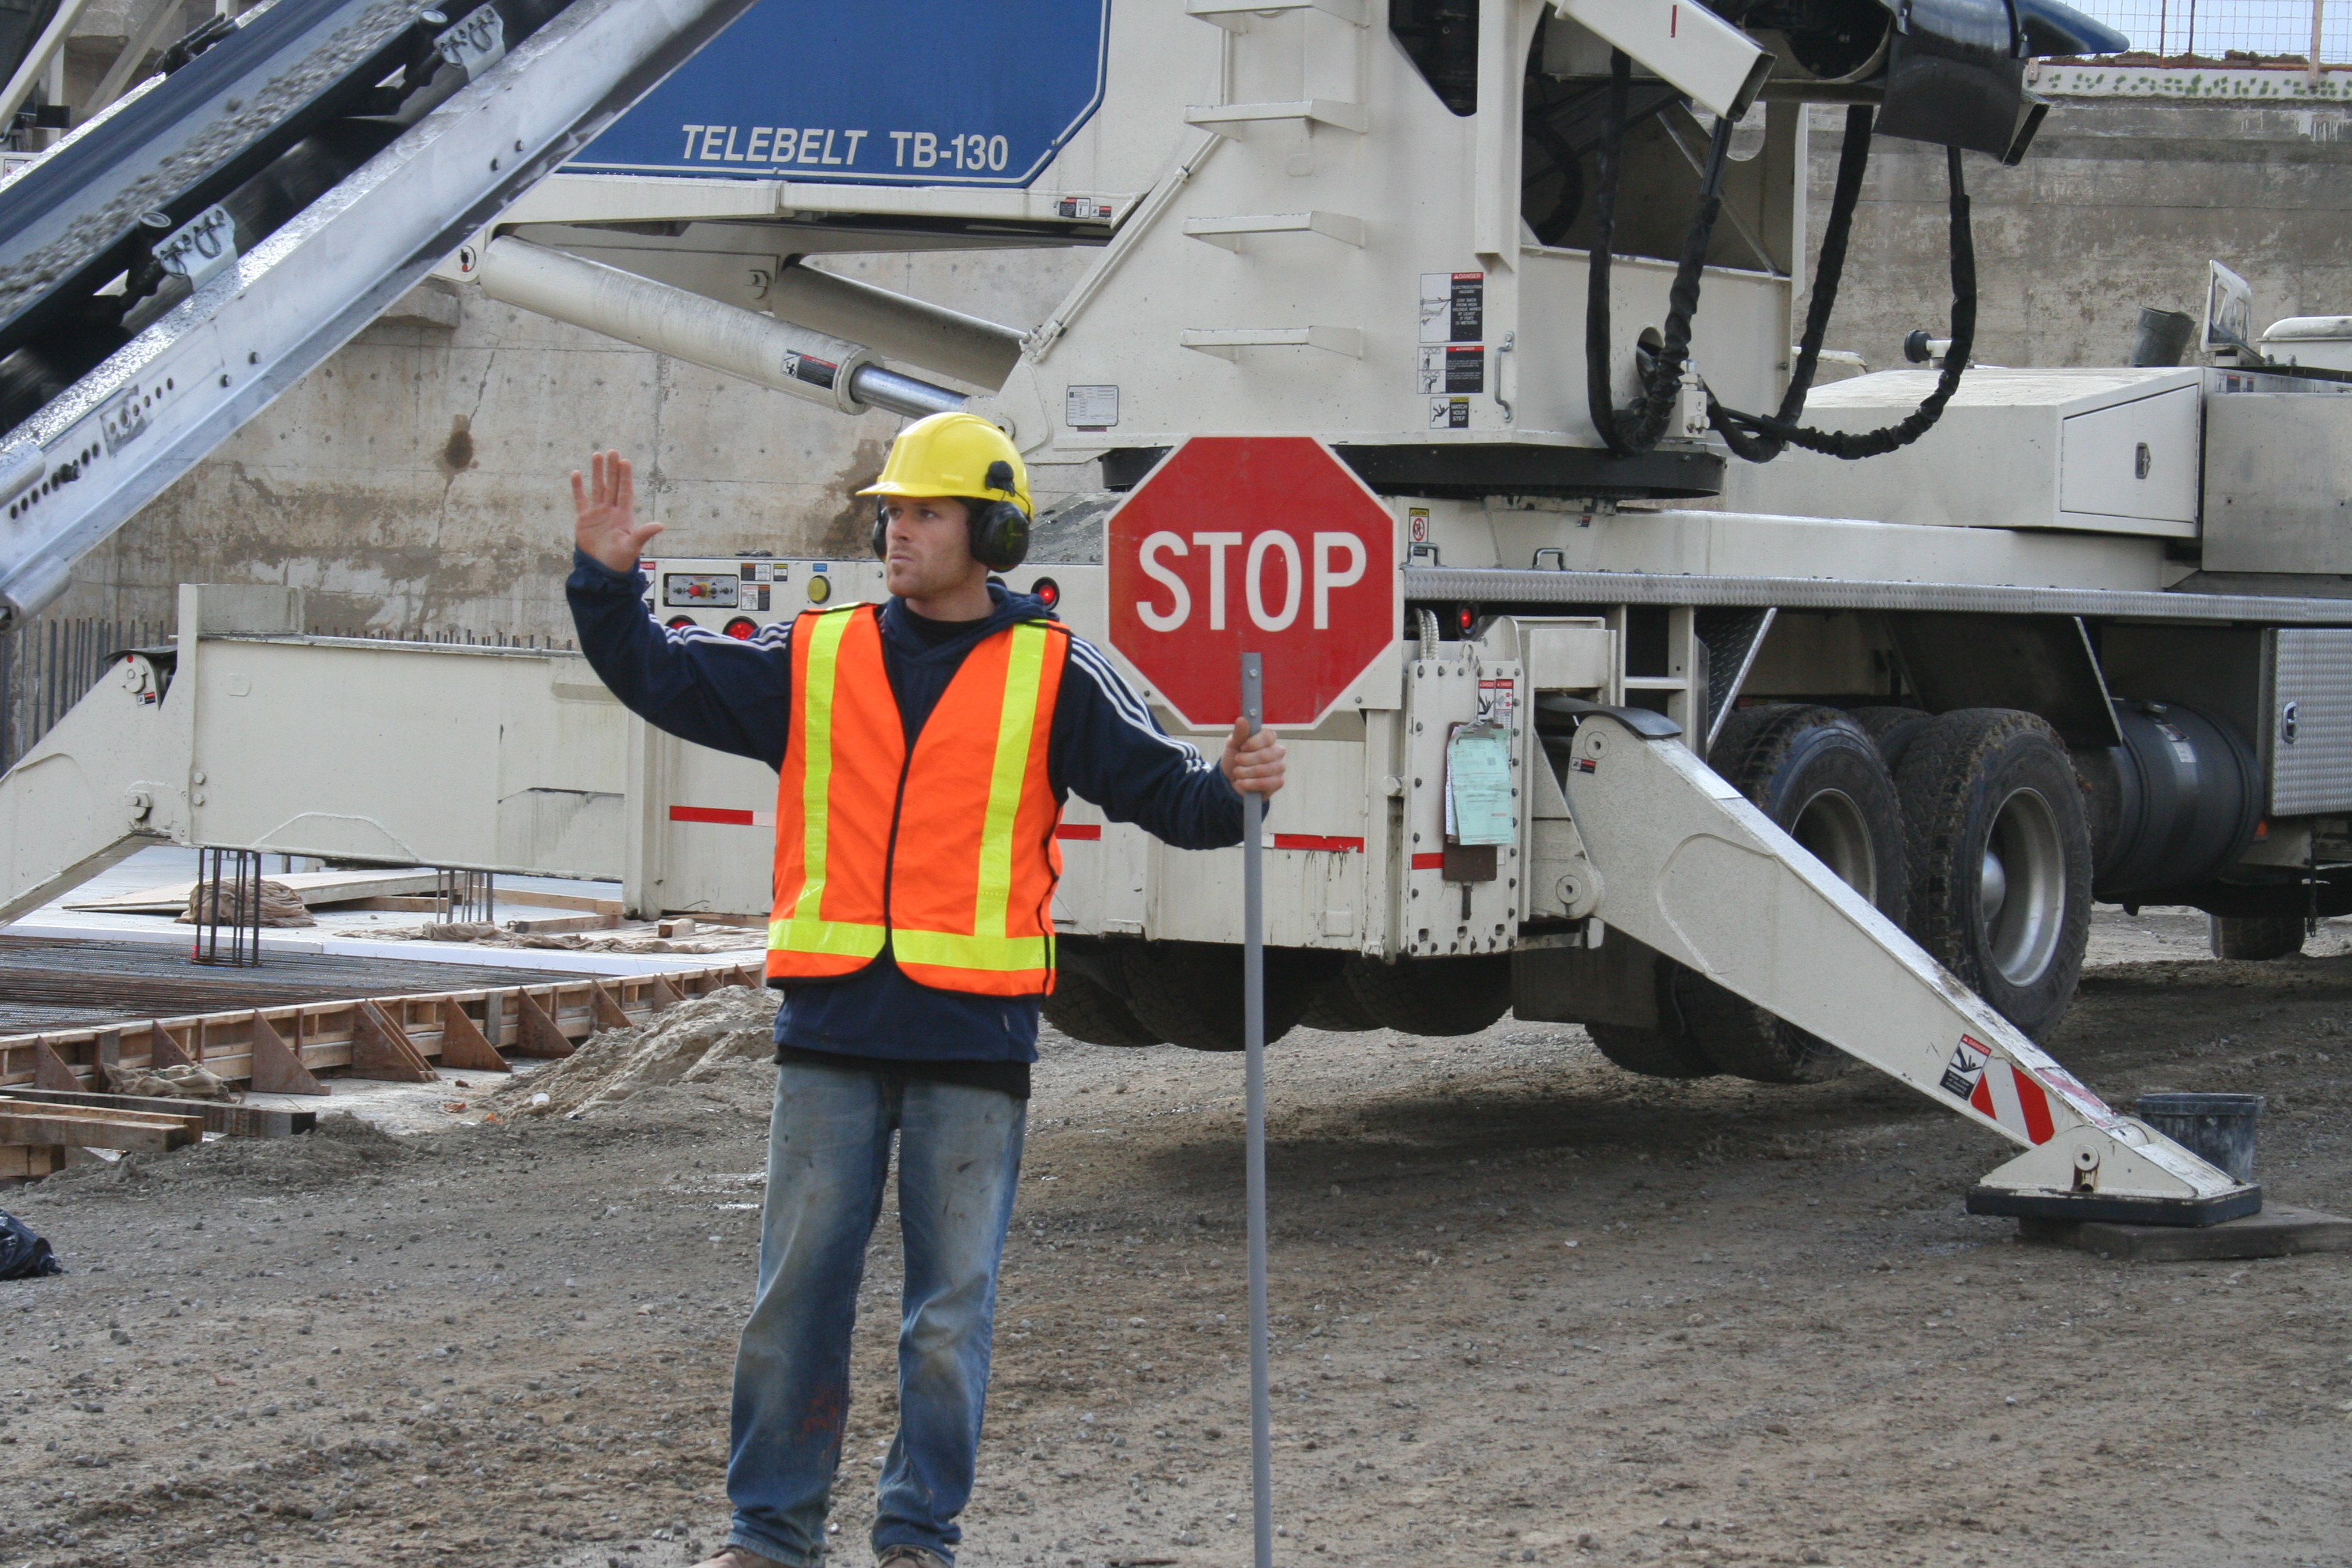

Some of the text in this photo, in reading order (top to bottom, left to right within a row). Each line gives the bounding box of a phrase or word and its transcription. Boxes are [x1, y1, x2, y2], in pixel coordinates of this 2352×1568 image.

[682, 125, 1009, 171] TELEBELT TB-130
[1137, 529, 1367, 632] STOP
[1967, 1039, 1990, 1055] DANGER
